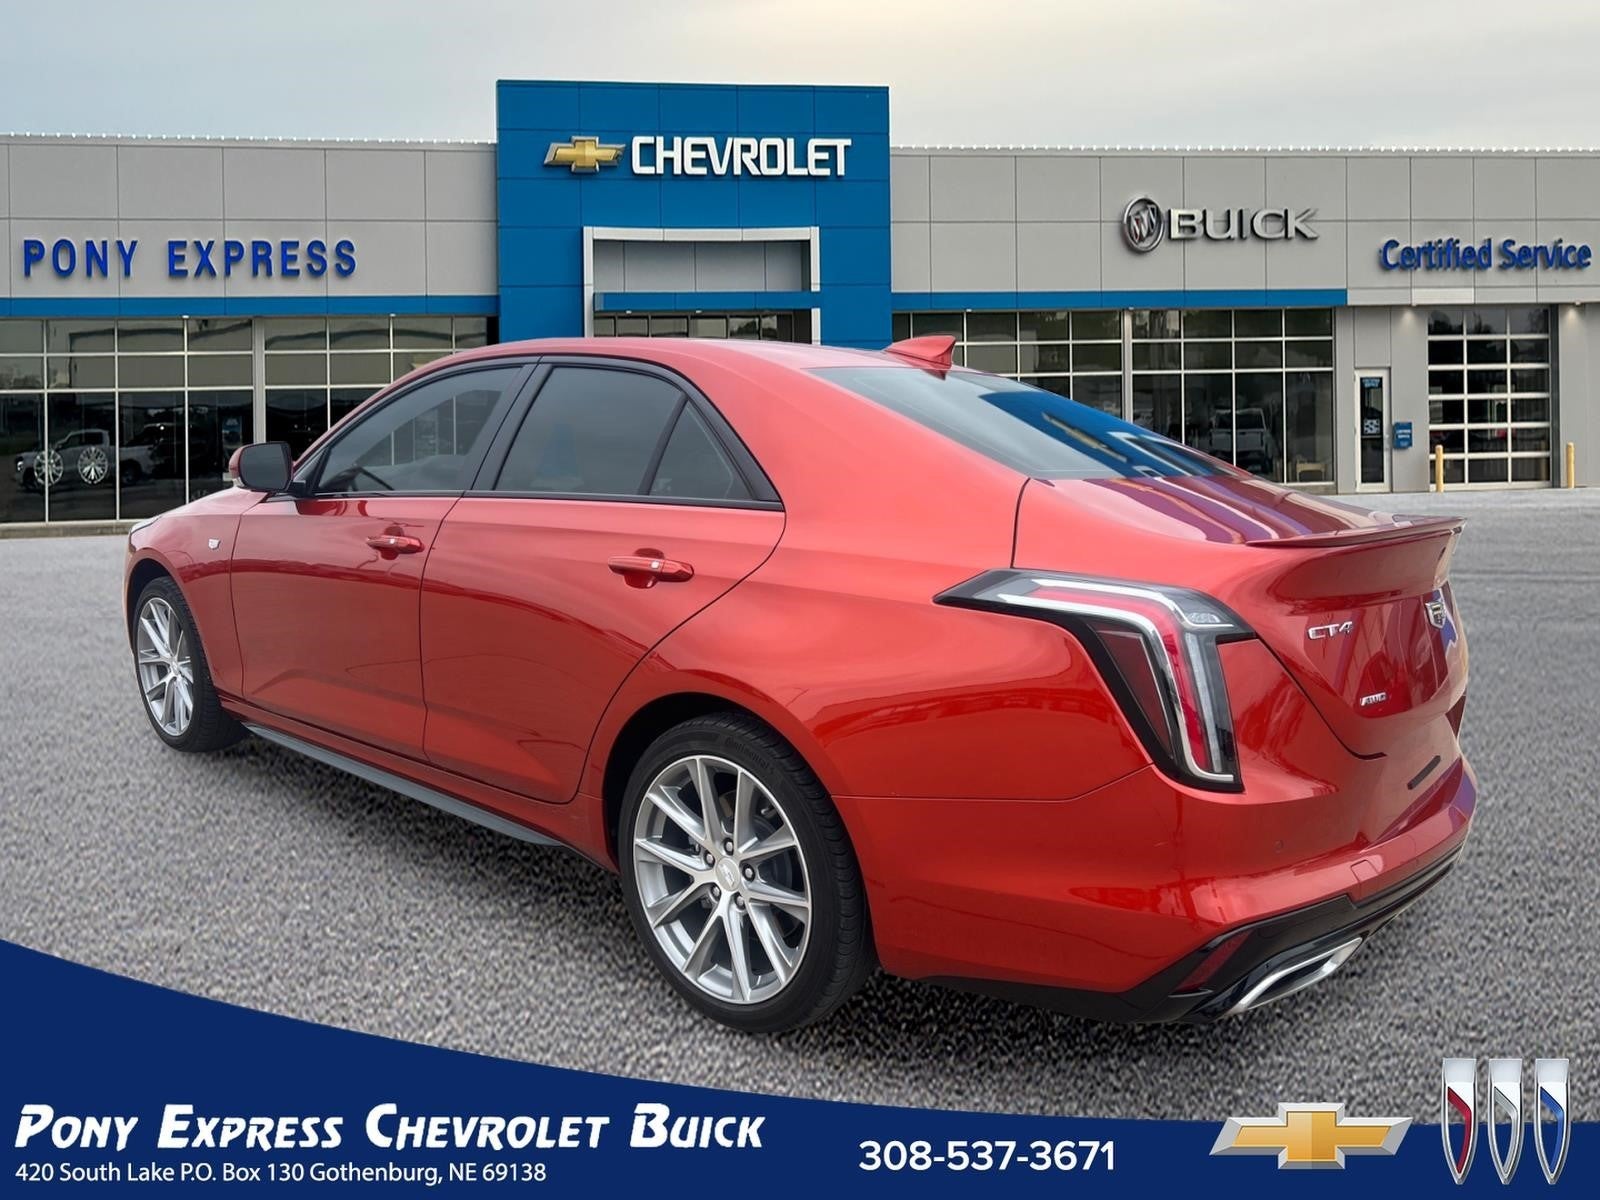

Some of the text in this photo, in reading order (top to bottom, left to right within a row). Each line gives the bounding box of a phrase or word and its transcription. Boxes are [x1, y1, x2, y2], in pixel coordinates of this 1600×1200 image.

[632, 136, 852, 177] CHEVROLET
[1168, 207, 1319, 241] BUICK
[23, 239, 357, 278] PONY EXPRESS
[1380, 237, 1593, 270] Certified Service
[1308, 621, 1353, 640] CT4
